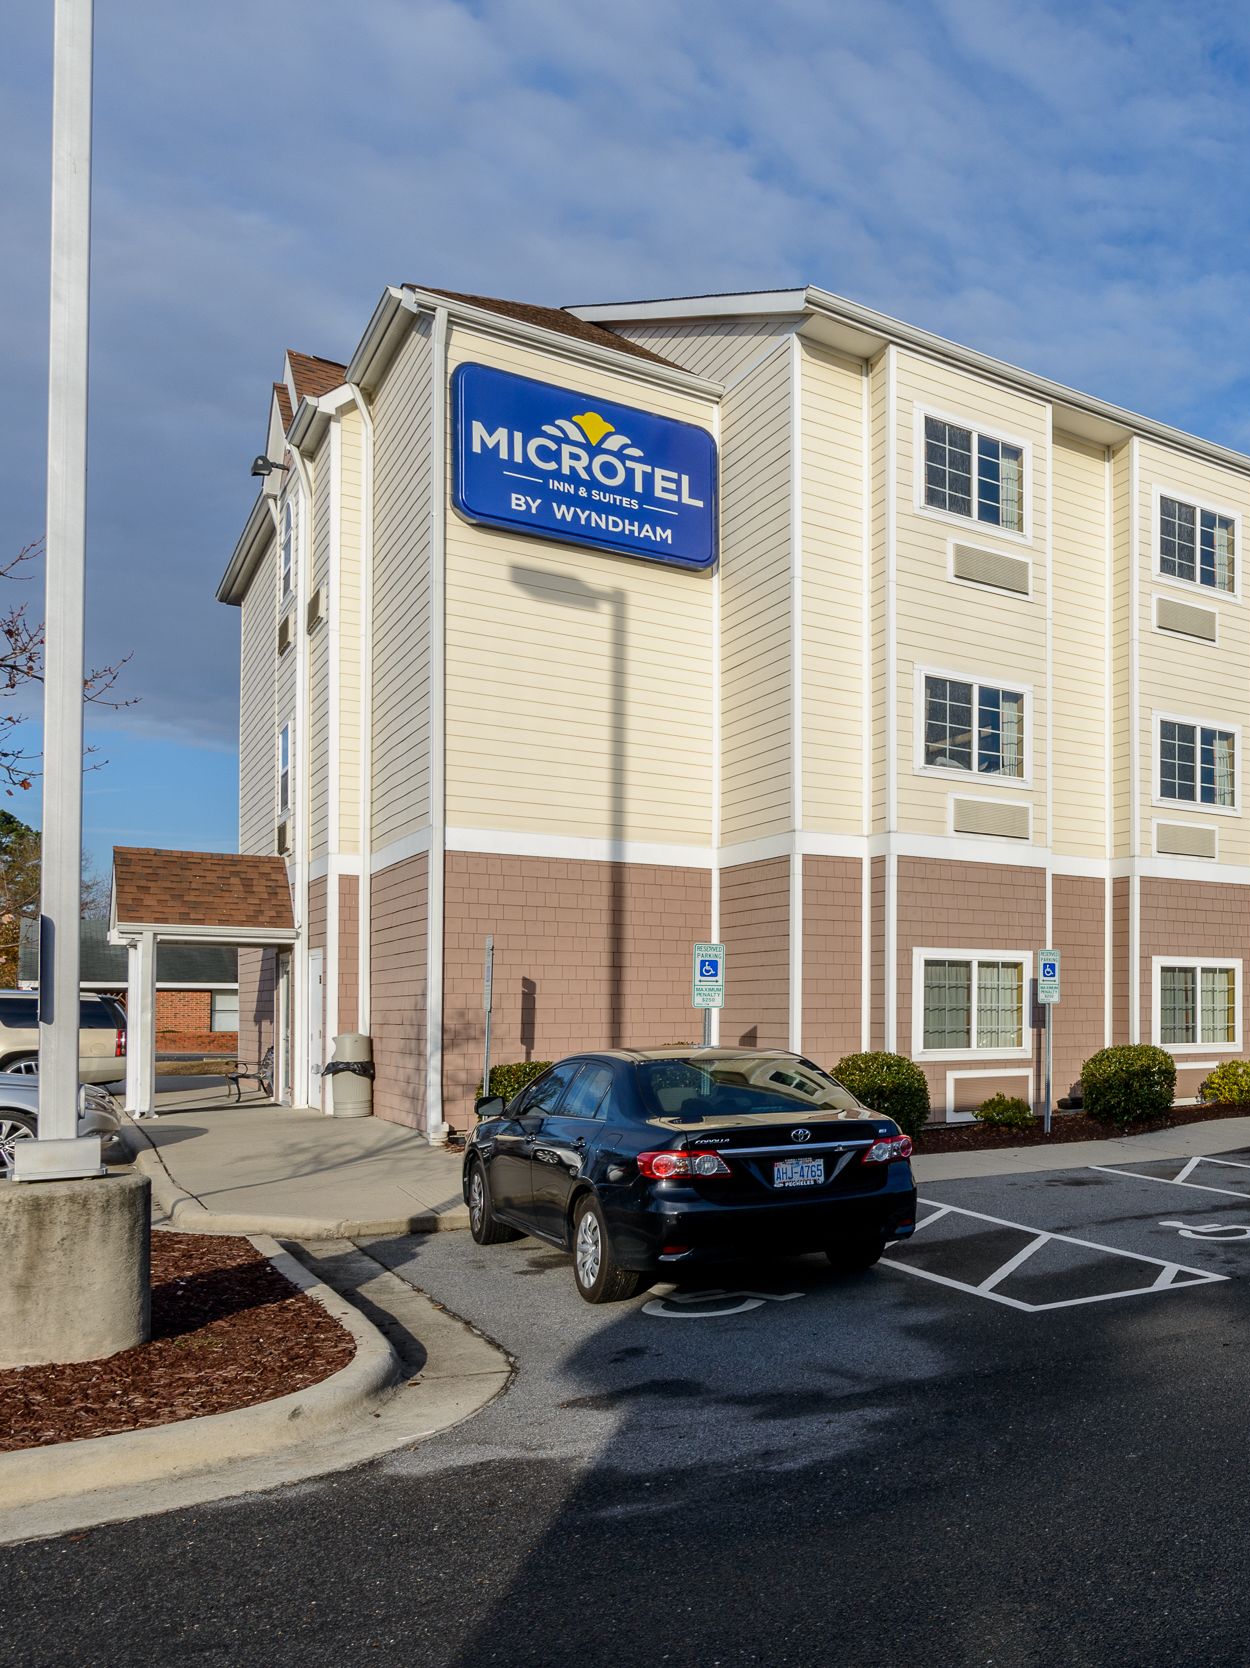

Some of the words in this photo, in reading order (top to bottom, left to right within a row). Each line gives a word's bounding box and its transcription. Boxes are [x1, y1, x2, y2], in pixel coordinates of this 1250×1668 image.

[471, 420, 704, 508] MICROTEL
[510, 492, 542, 514] BY
[552, 502, 673, 545] WYNDHAM
[549, 478, 575, 494] INN
[578, 486, 588, 498] &
[591, 489, 639, 510] SUITES
